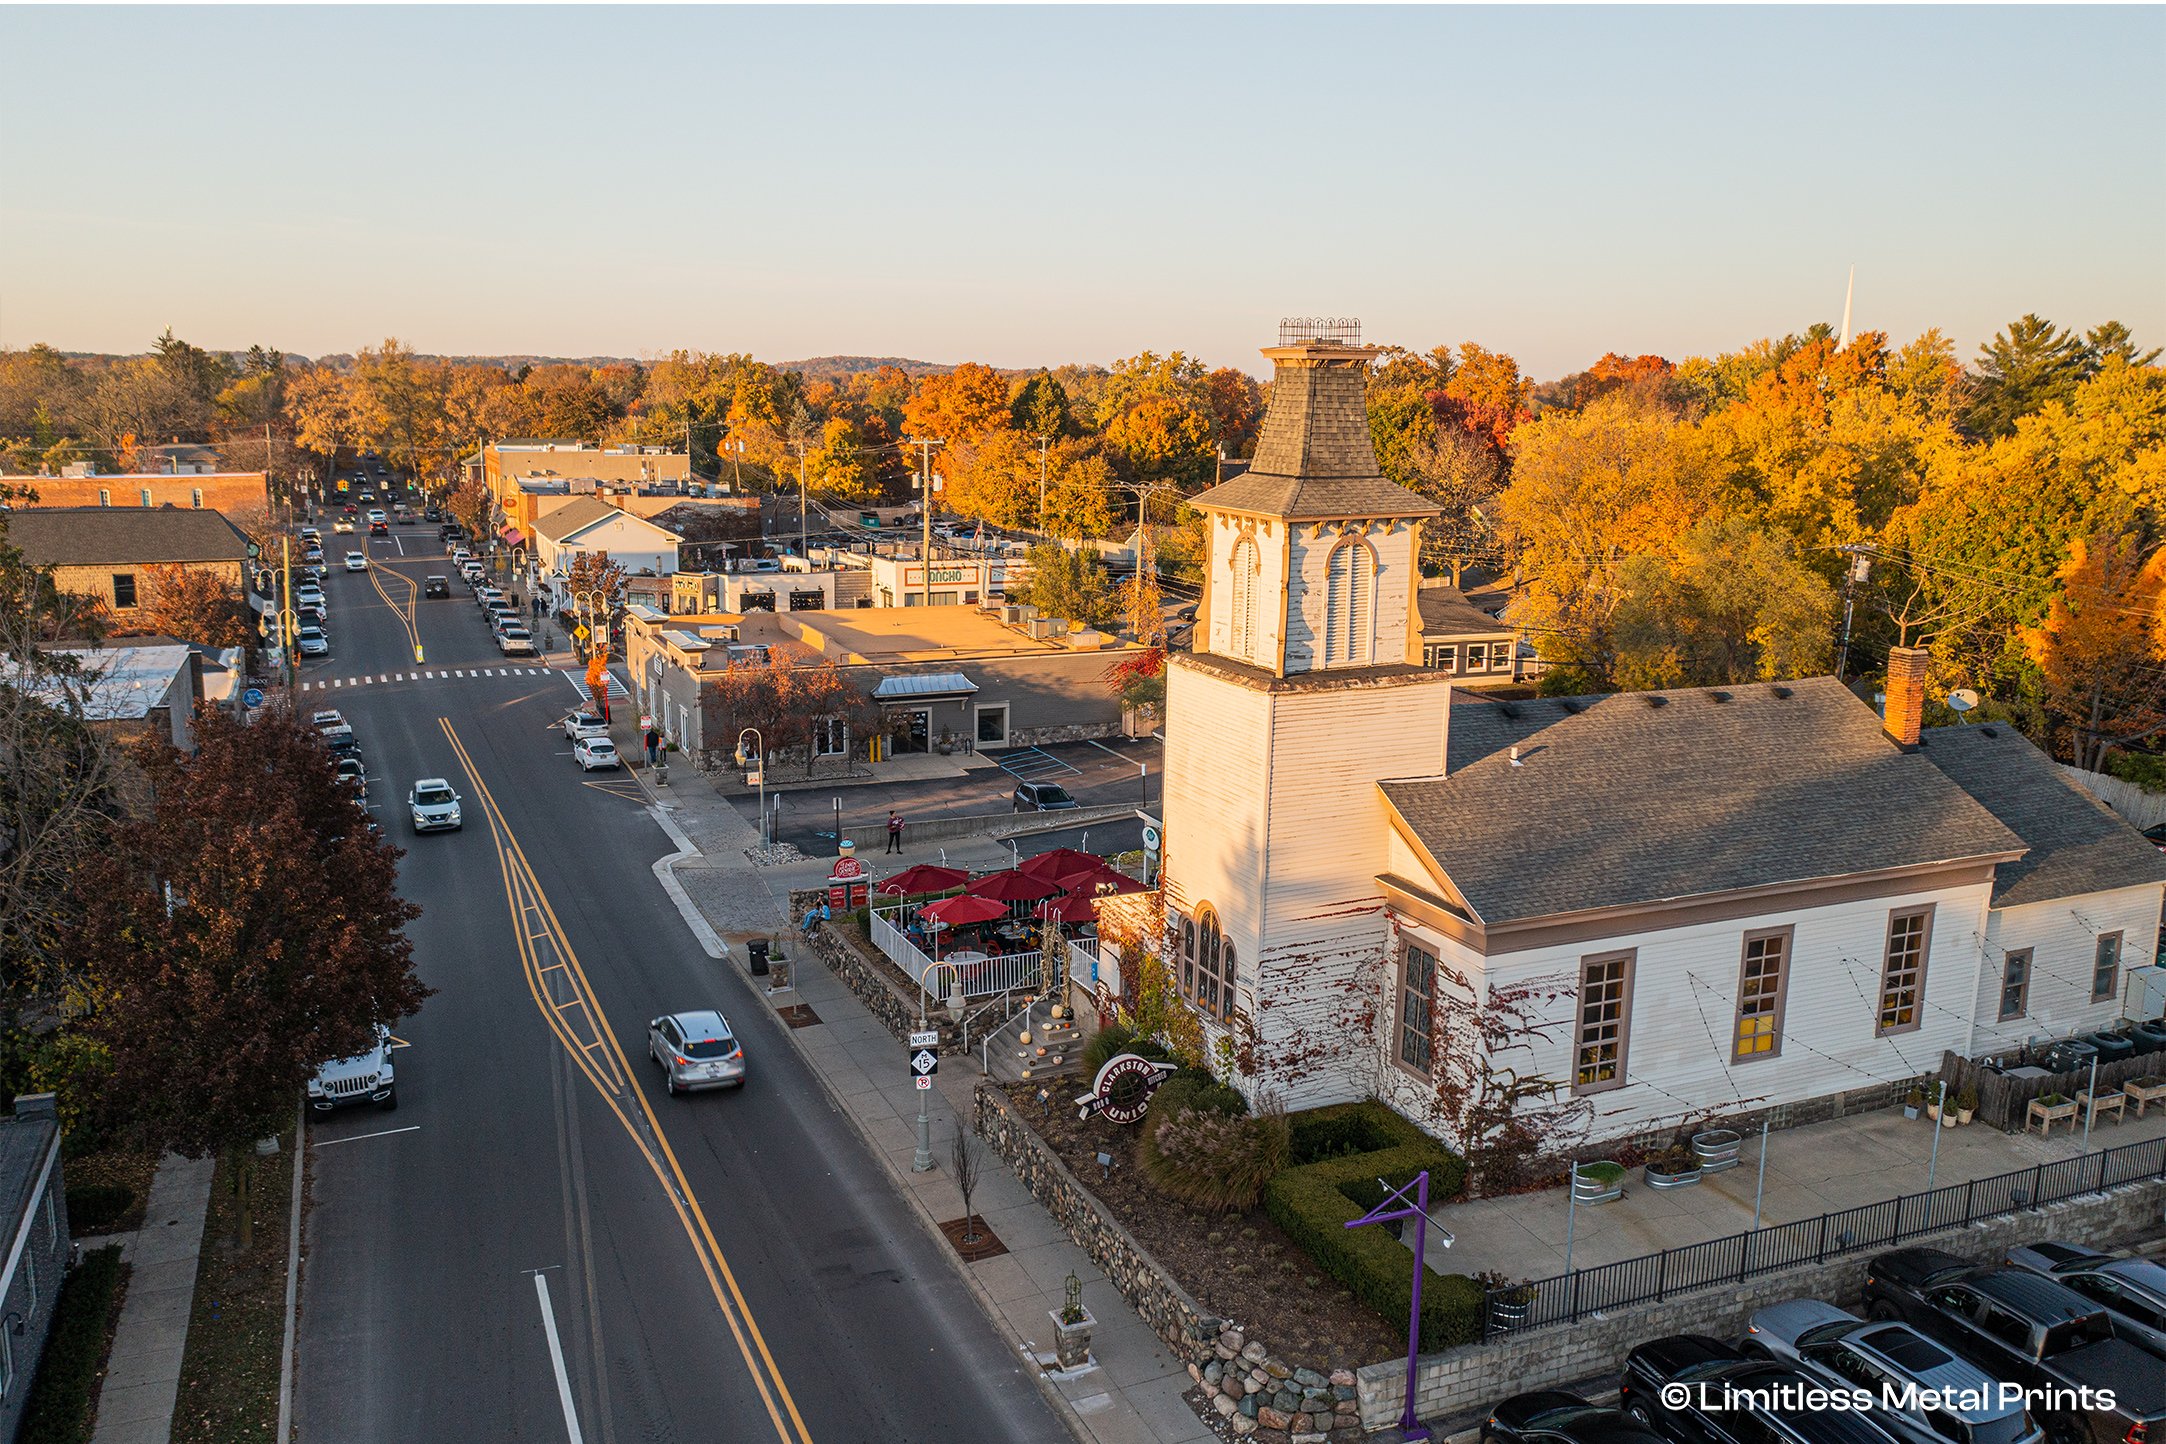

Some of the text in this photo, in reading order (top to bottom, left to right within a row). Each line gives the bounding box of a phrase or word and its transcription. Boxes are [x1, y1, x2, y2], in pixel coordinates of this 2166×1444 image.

[922, 570, 962, 583] ONCHO
[912, 1034, 937, 1044] NORTH
[918, 1058, 930, 1069] 15
[1101, 1060, 1151, 1093] CLARKSTON
[1108, 1090, 1154, 1121] UNION
